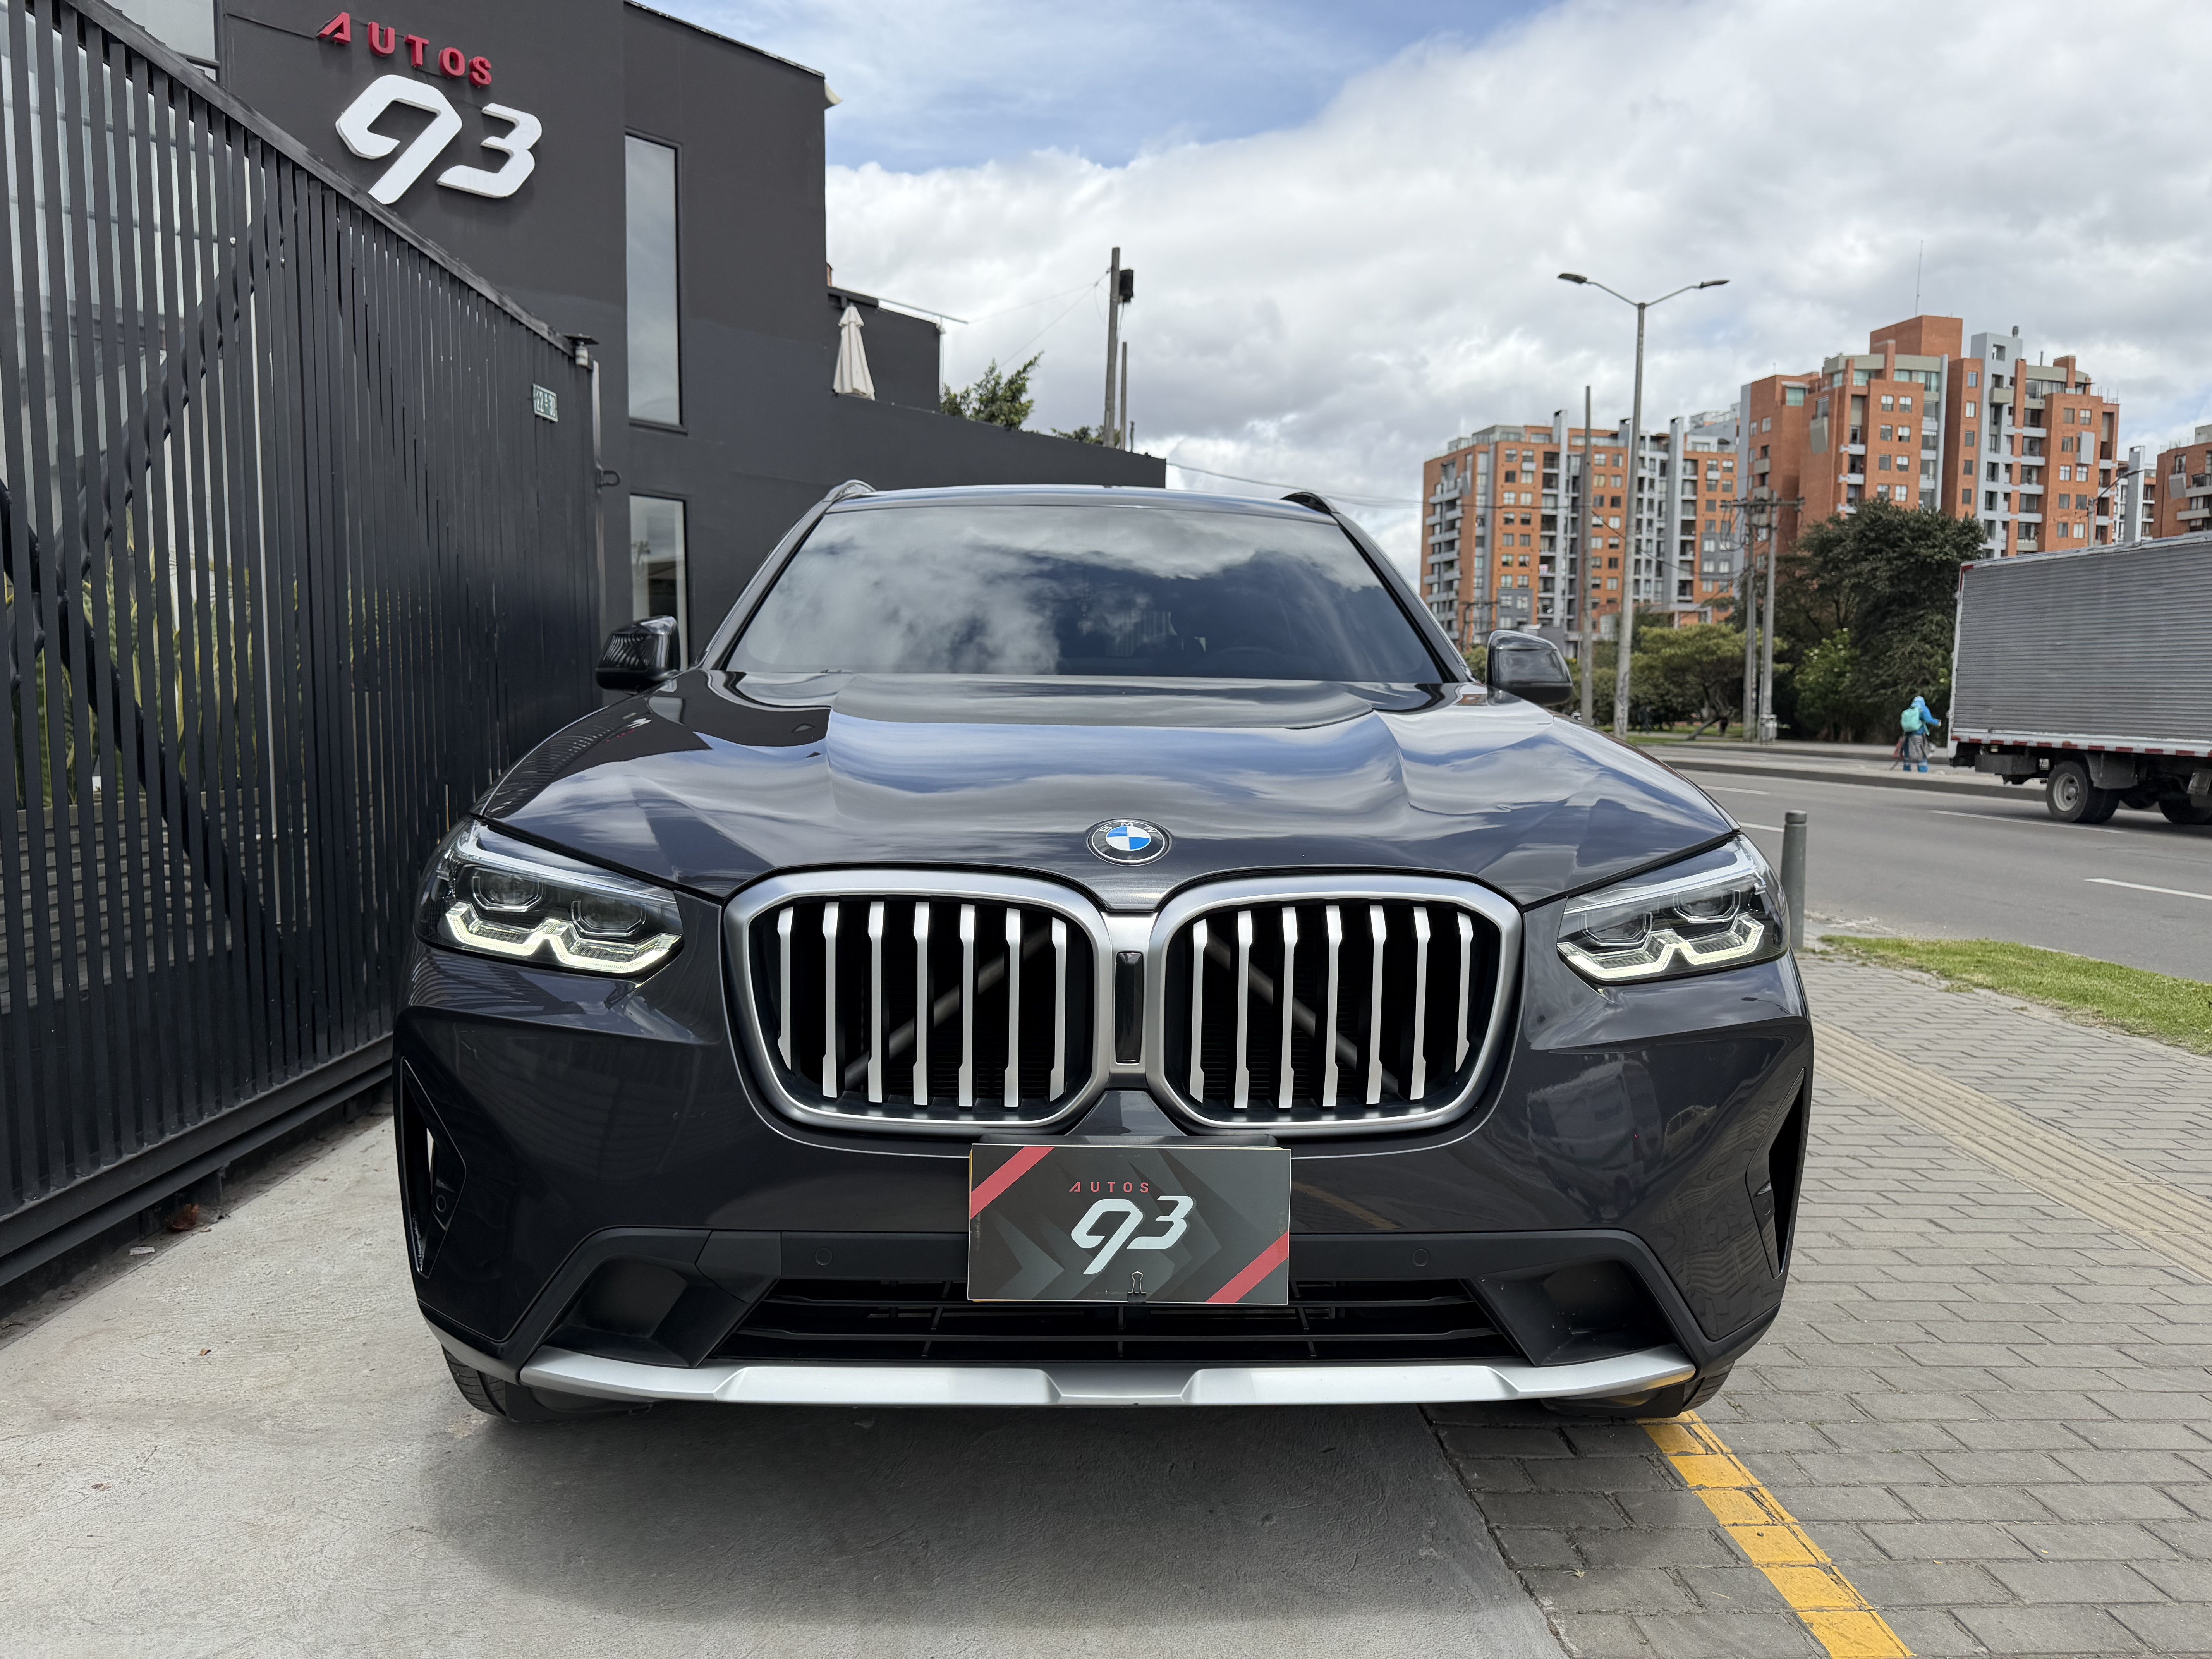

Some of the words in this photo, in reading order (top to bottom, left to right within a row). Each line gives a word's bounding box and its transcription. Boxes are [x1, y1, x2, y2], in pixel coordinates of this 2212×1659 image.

[317, 12, 492, 87] AUTOS
[336, 74, 542, 204] 93
[1099, 822, 1157, 833] BMW
[1069, 1182, 1149, 1192] AUTOS
[1072, 1196, 1193, 1274] 93
